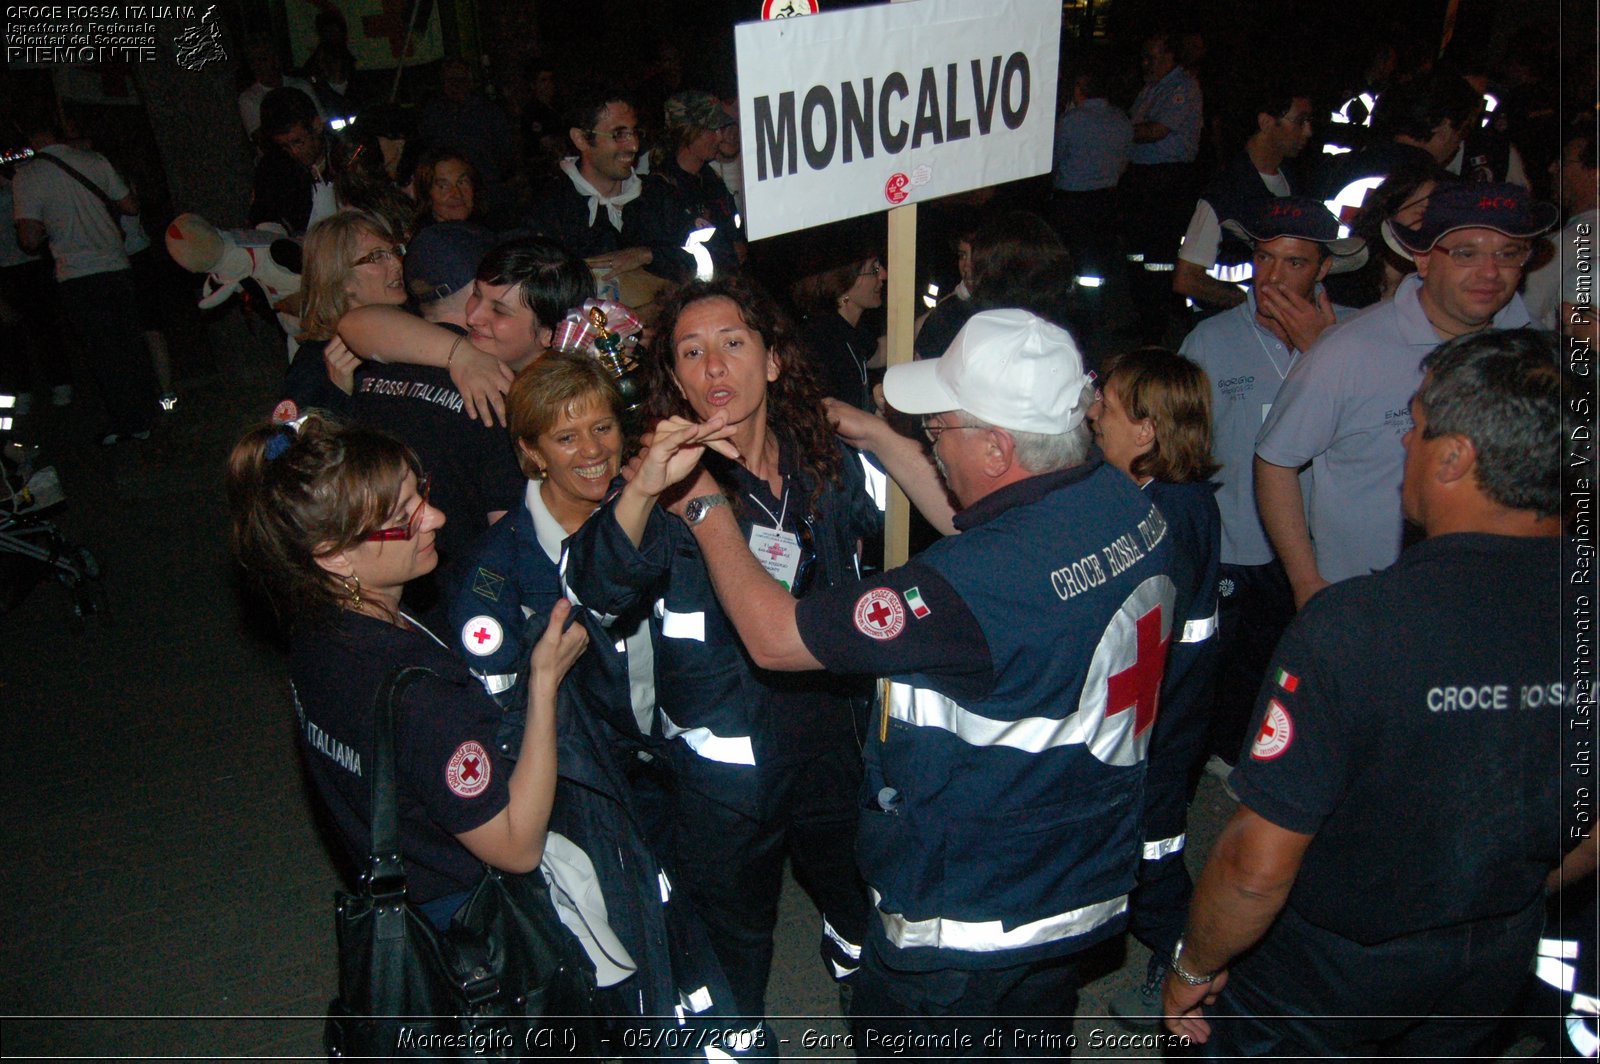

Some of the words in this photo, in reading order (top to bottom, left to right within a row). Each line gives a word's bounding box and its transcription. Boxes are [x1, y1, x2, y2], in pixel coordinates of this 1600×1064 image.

[753, 51, 1030, 182] MONCALVO
[372, 379, 410, 397] ROSSA
[407, 382, 464, 413] ITALIANA
[1051, 553, 1106, 600] CROCE
[1102, 532, 1145, 577] ROSSA
[1427, 684, 1508, 712] CROCE
[307, 720, 362, 777] ITALIANA
